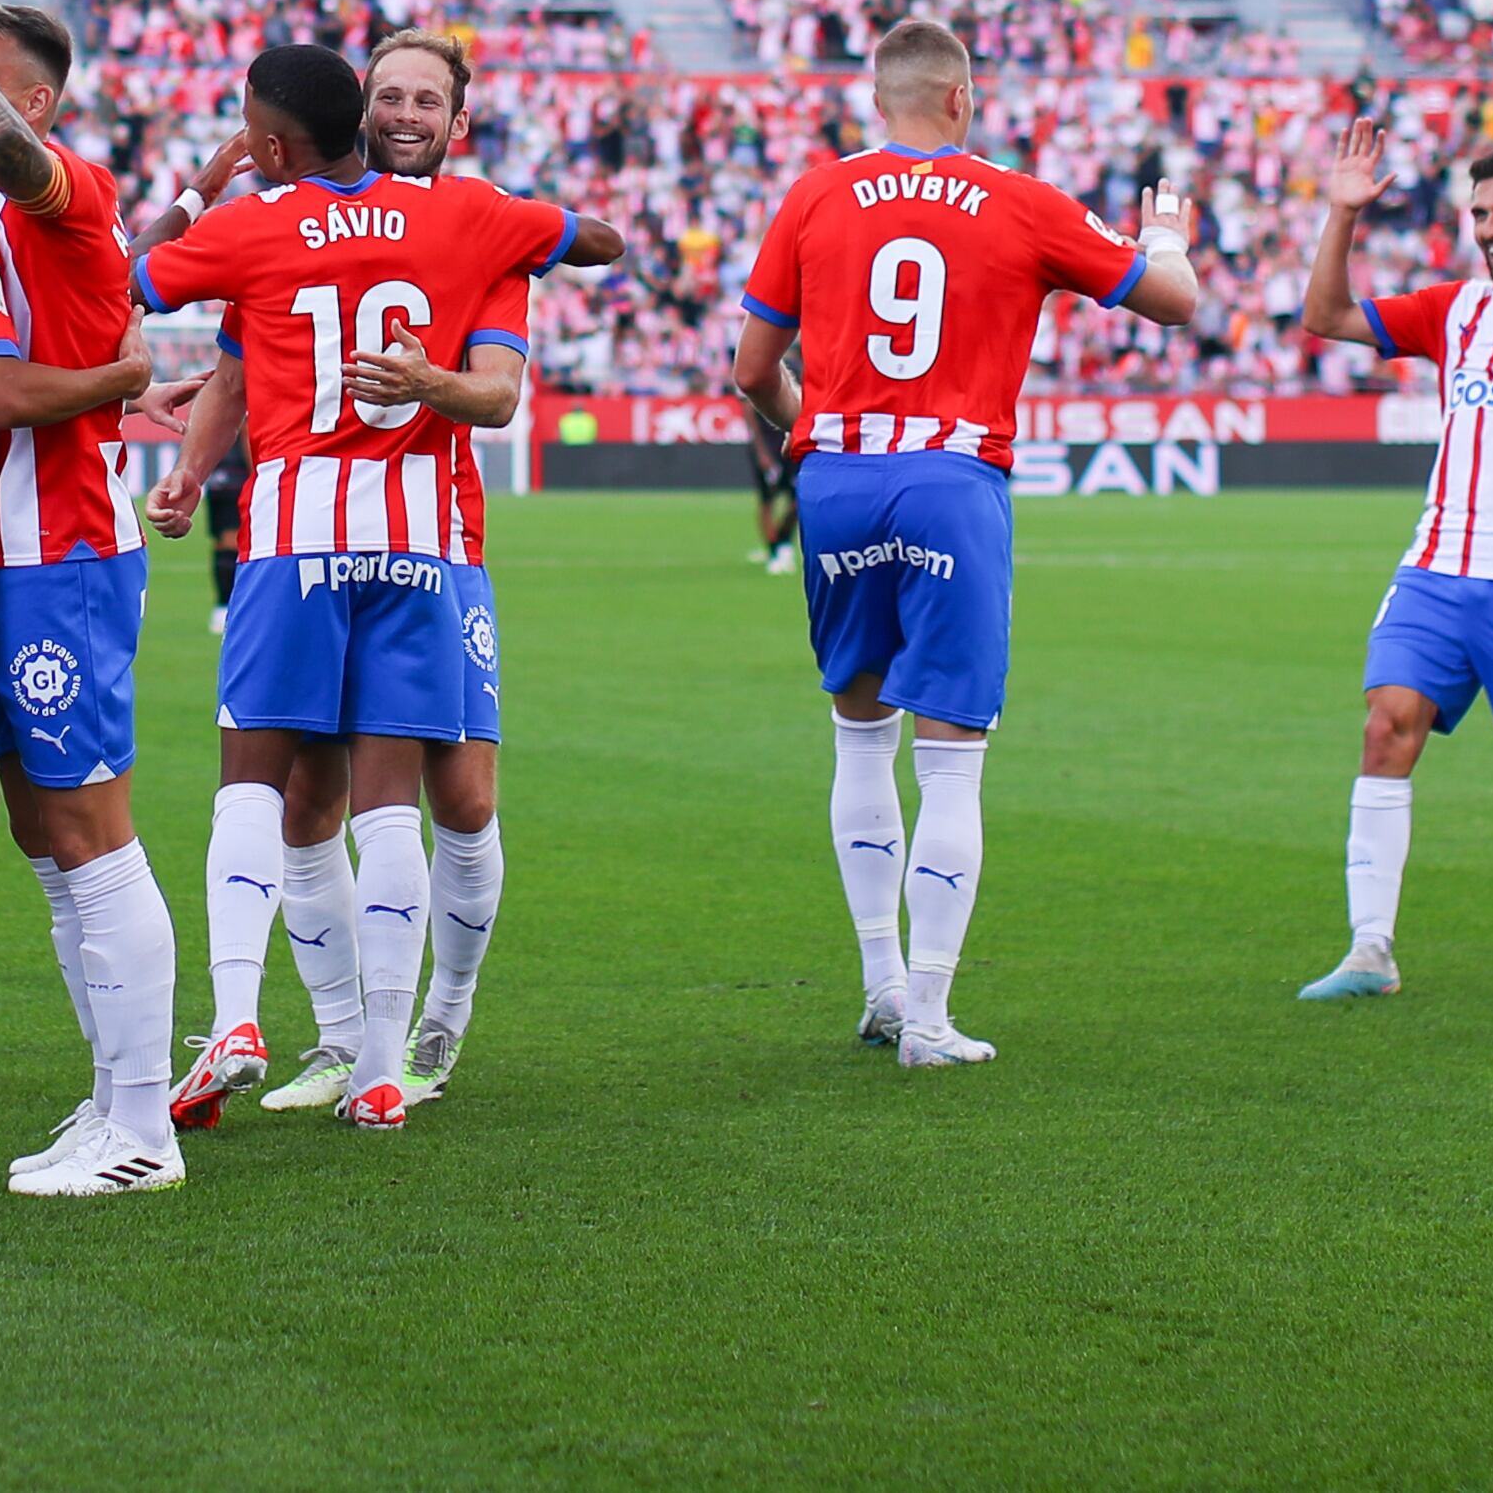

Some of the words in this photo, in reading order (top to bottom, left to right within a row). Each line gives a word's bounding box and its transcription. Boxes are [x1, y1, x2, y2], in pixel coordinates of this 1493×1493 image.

[852, 172, 990, 217] DOVBYK
[299, 202, 406, 249] SÁVIO
[867, 237, 947, 381] 9
[290, 280, 432, 434] 16
[329, 552, 442, 595] parlem
[839, 536, 955, 581] parlem
[9, 643, 39, 675] Costa
[41, 639, 78, 670] Brava
[11, 680, 40, 716] Pirineu
[41, 706, 57, 717] de
[57, 674, 81, 711] Girona
[32, 669, 57, 691] G!
